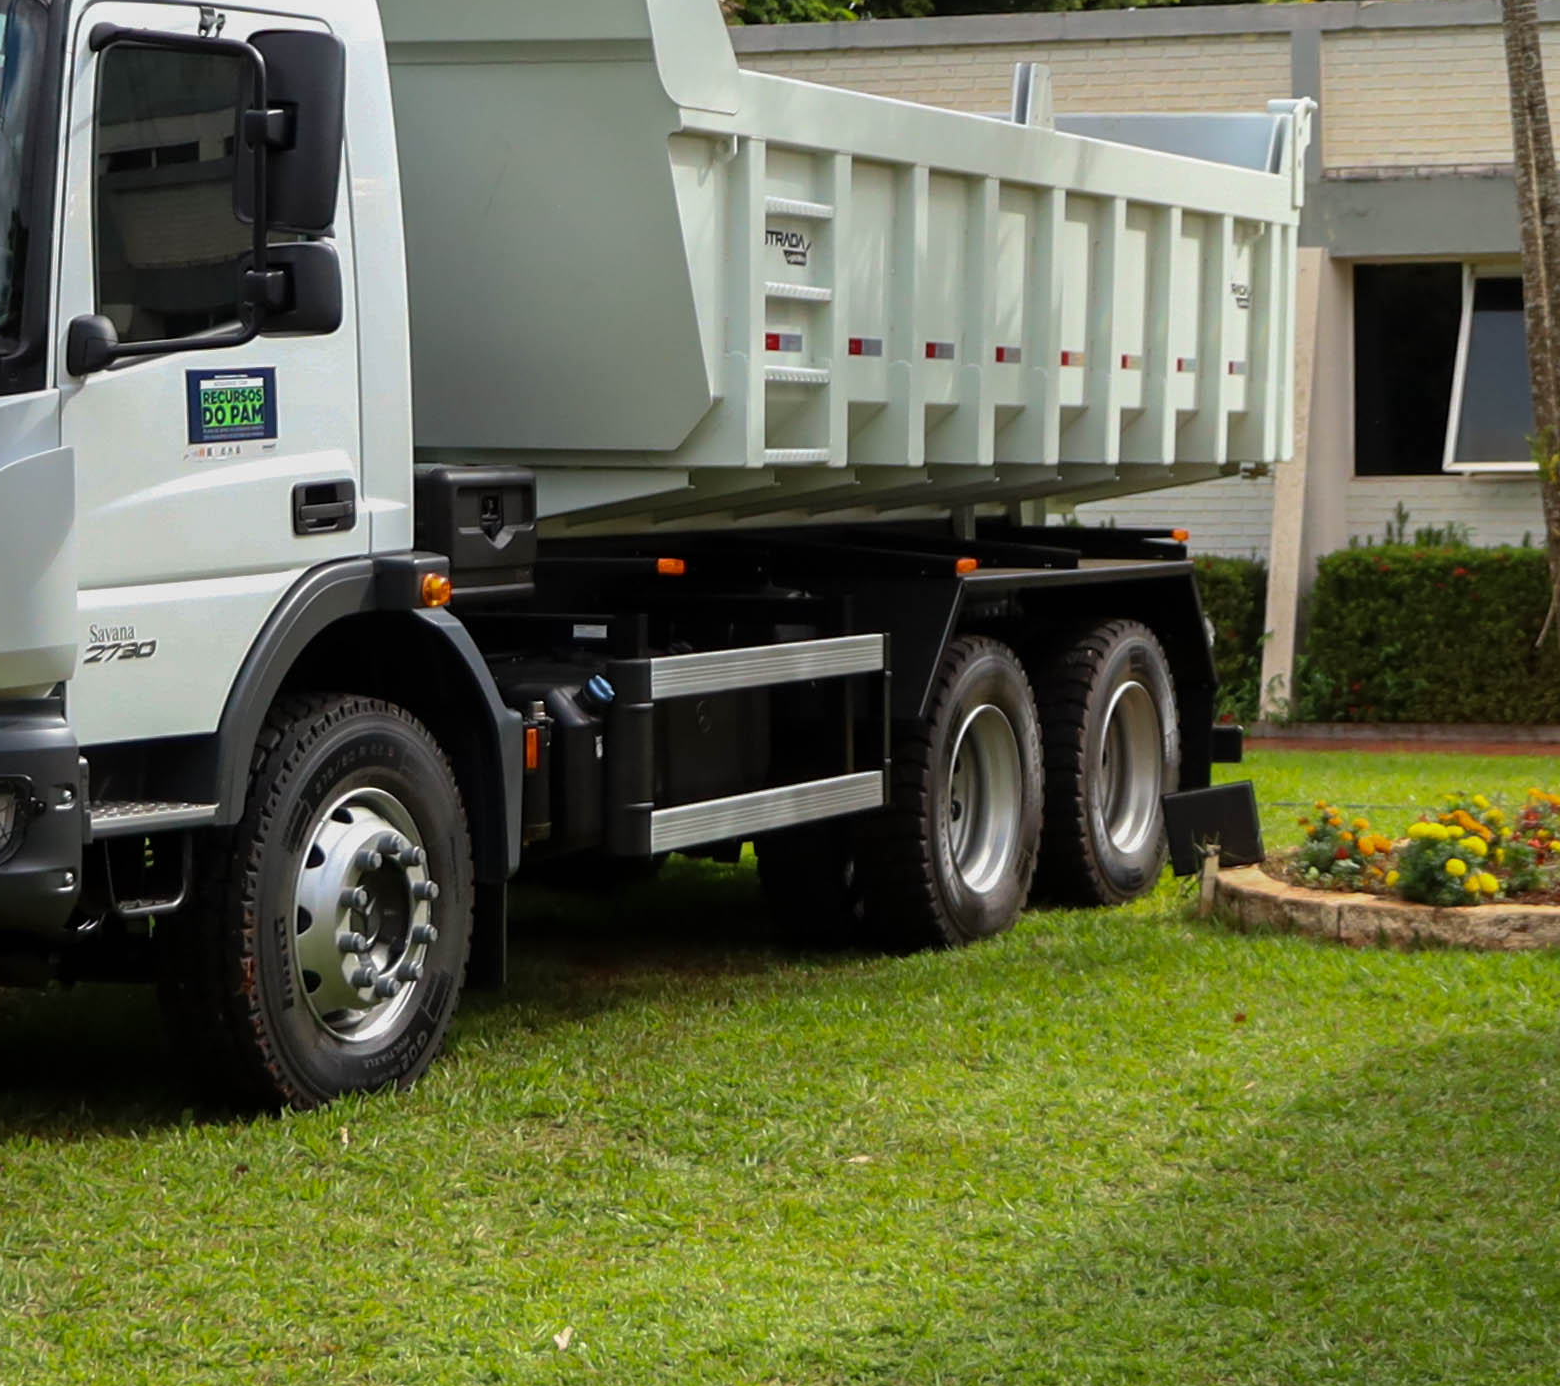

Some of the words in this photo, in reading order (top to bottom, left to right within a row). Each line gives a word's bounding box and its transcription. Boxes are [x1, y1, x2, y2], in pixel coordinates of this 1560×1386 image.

[203, 389, 263, 405] RECURSOS
[203, 406, 226, 425] DO
[230, 404, 265, 424] PAM
[89, 624, 136, 643] Savana
[83, 639, 158, 665] 2730
